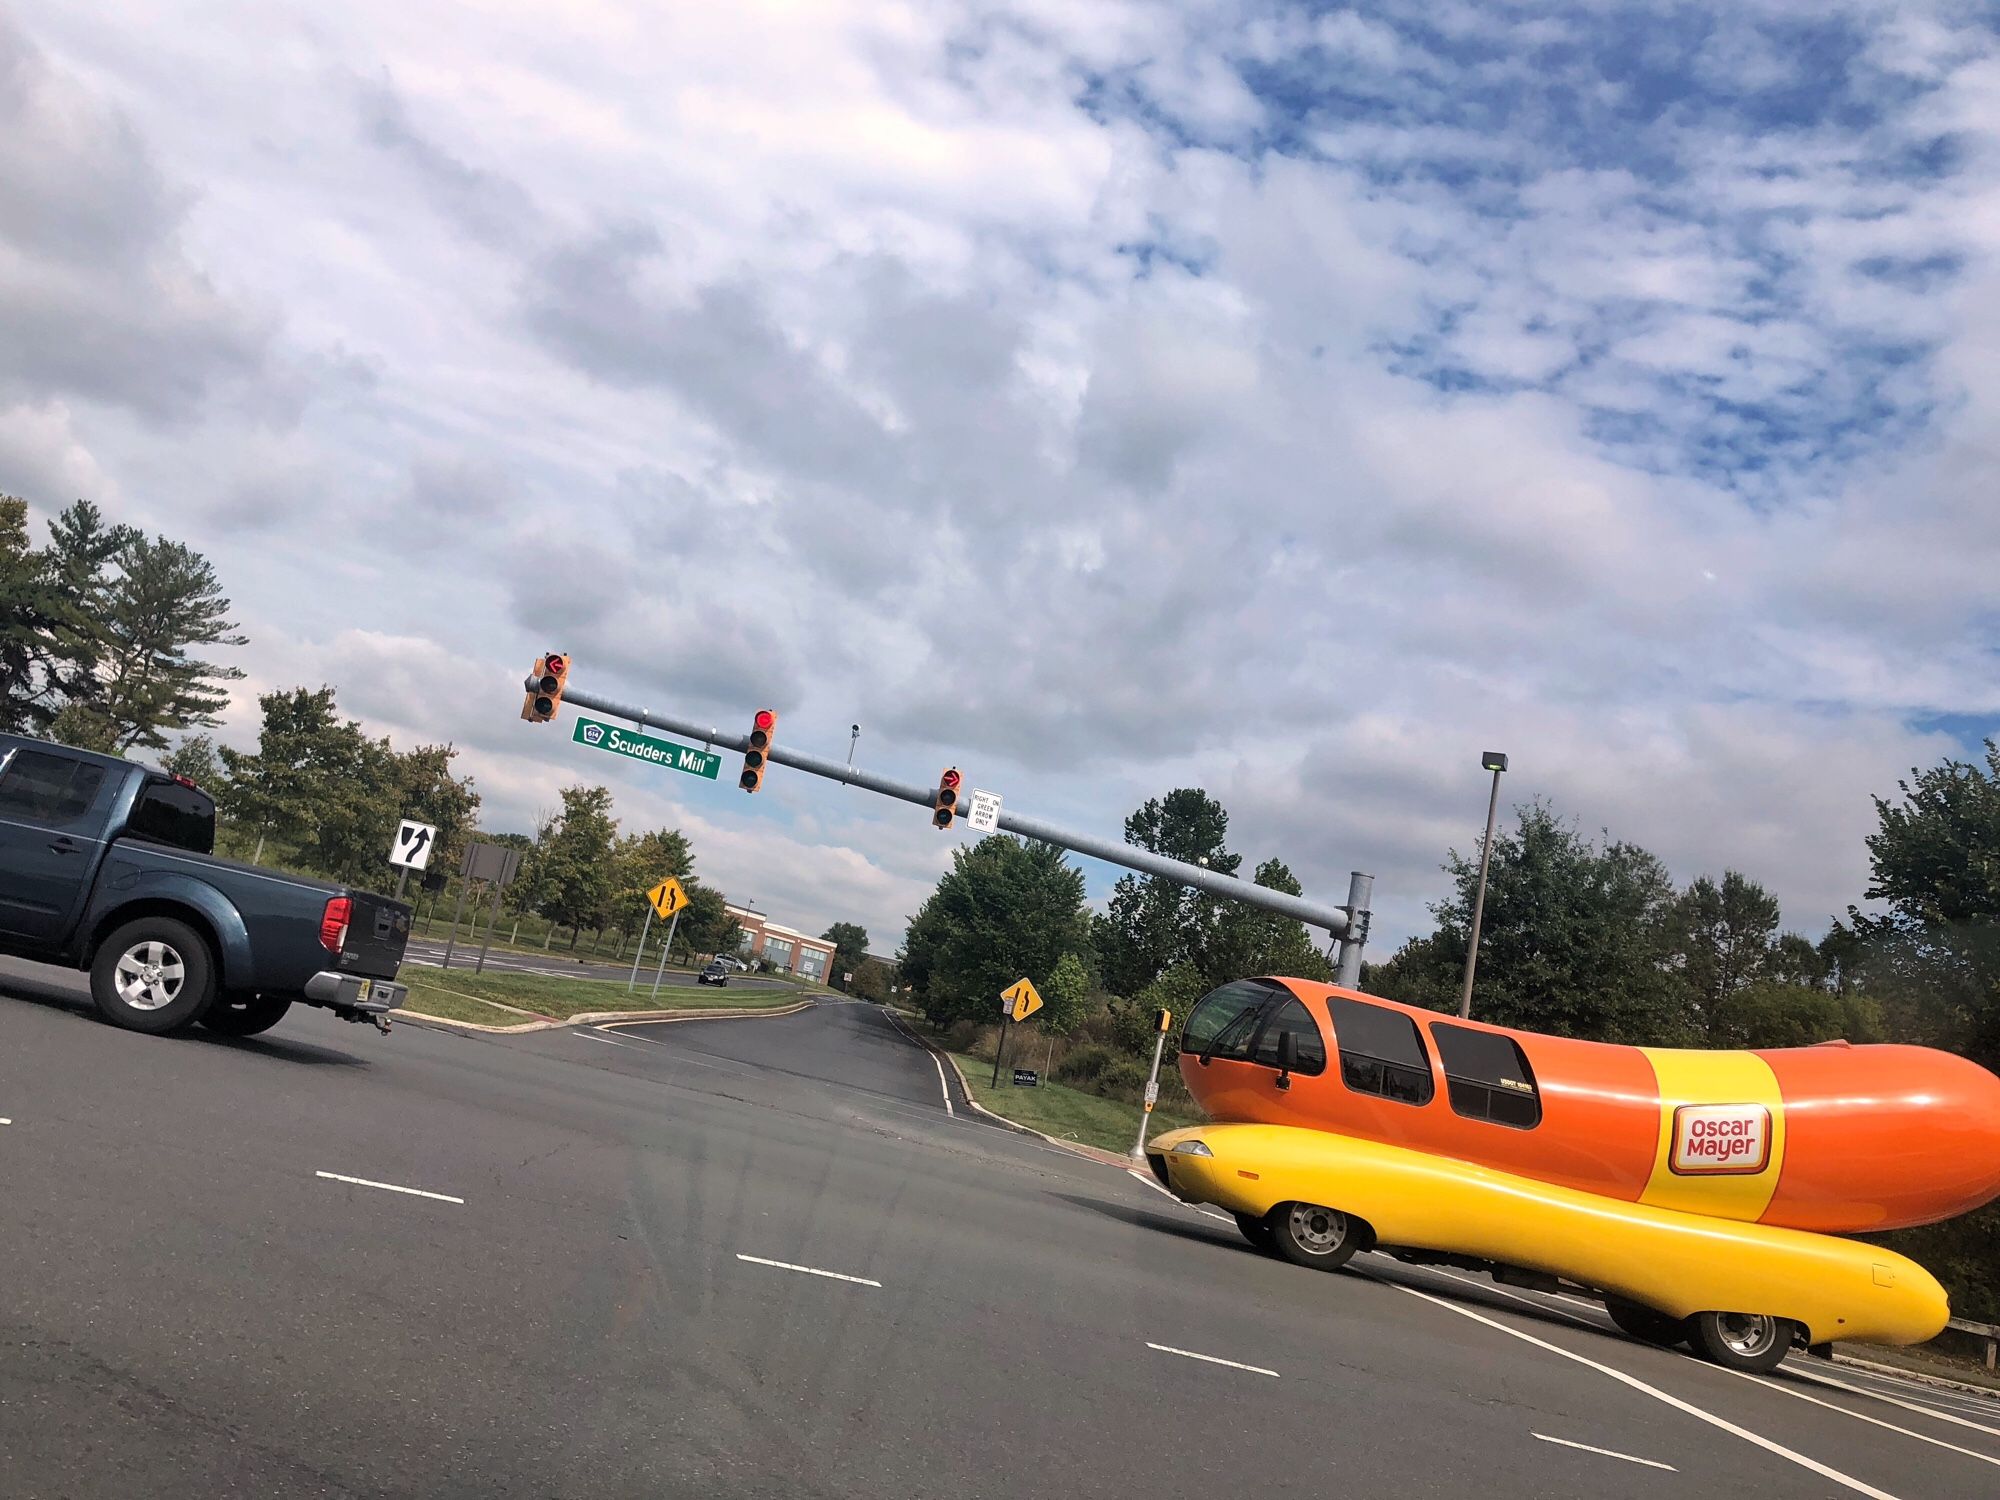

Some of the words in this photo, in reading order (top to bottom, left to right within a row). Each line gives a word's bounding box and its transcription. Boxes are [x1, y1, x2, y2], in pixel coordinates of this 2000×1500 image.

[587, 730, 599, 739] 614
[608, 730, 673, 764] Scudders
[678, 749, 706, 773] Mill
[974, 794, 989, 804] RIGHT
[992, 799, 1000, 807] ON
[976, 803, 994, 812] GREEN
[975, 810, 993, 820] ARROW
[975, 818, 989, 826] ONLY
[1691, 1120, 1754, 1138] Oscar
[1686, 1138, 1756, 1161] Mayer
